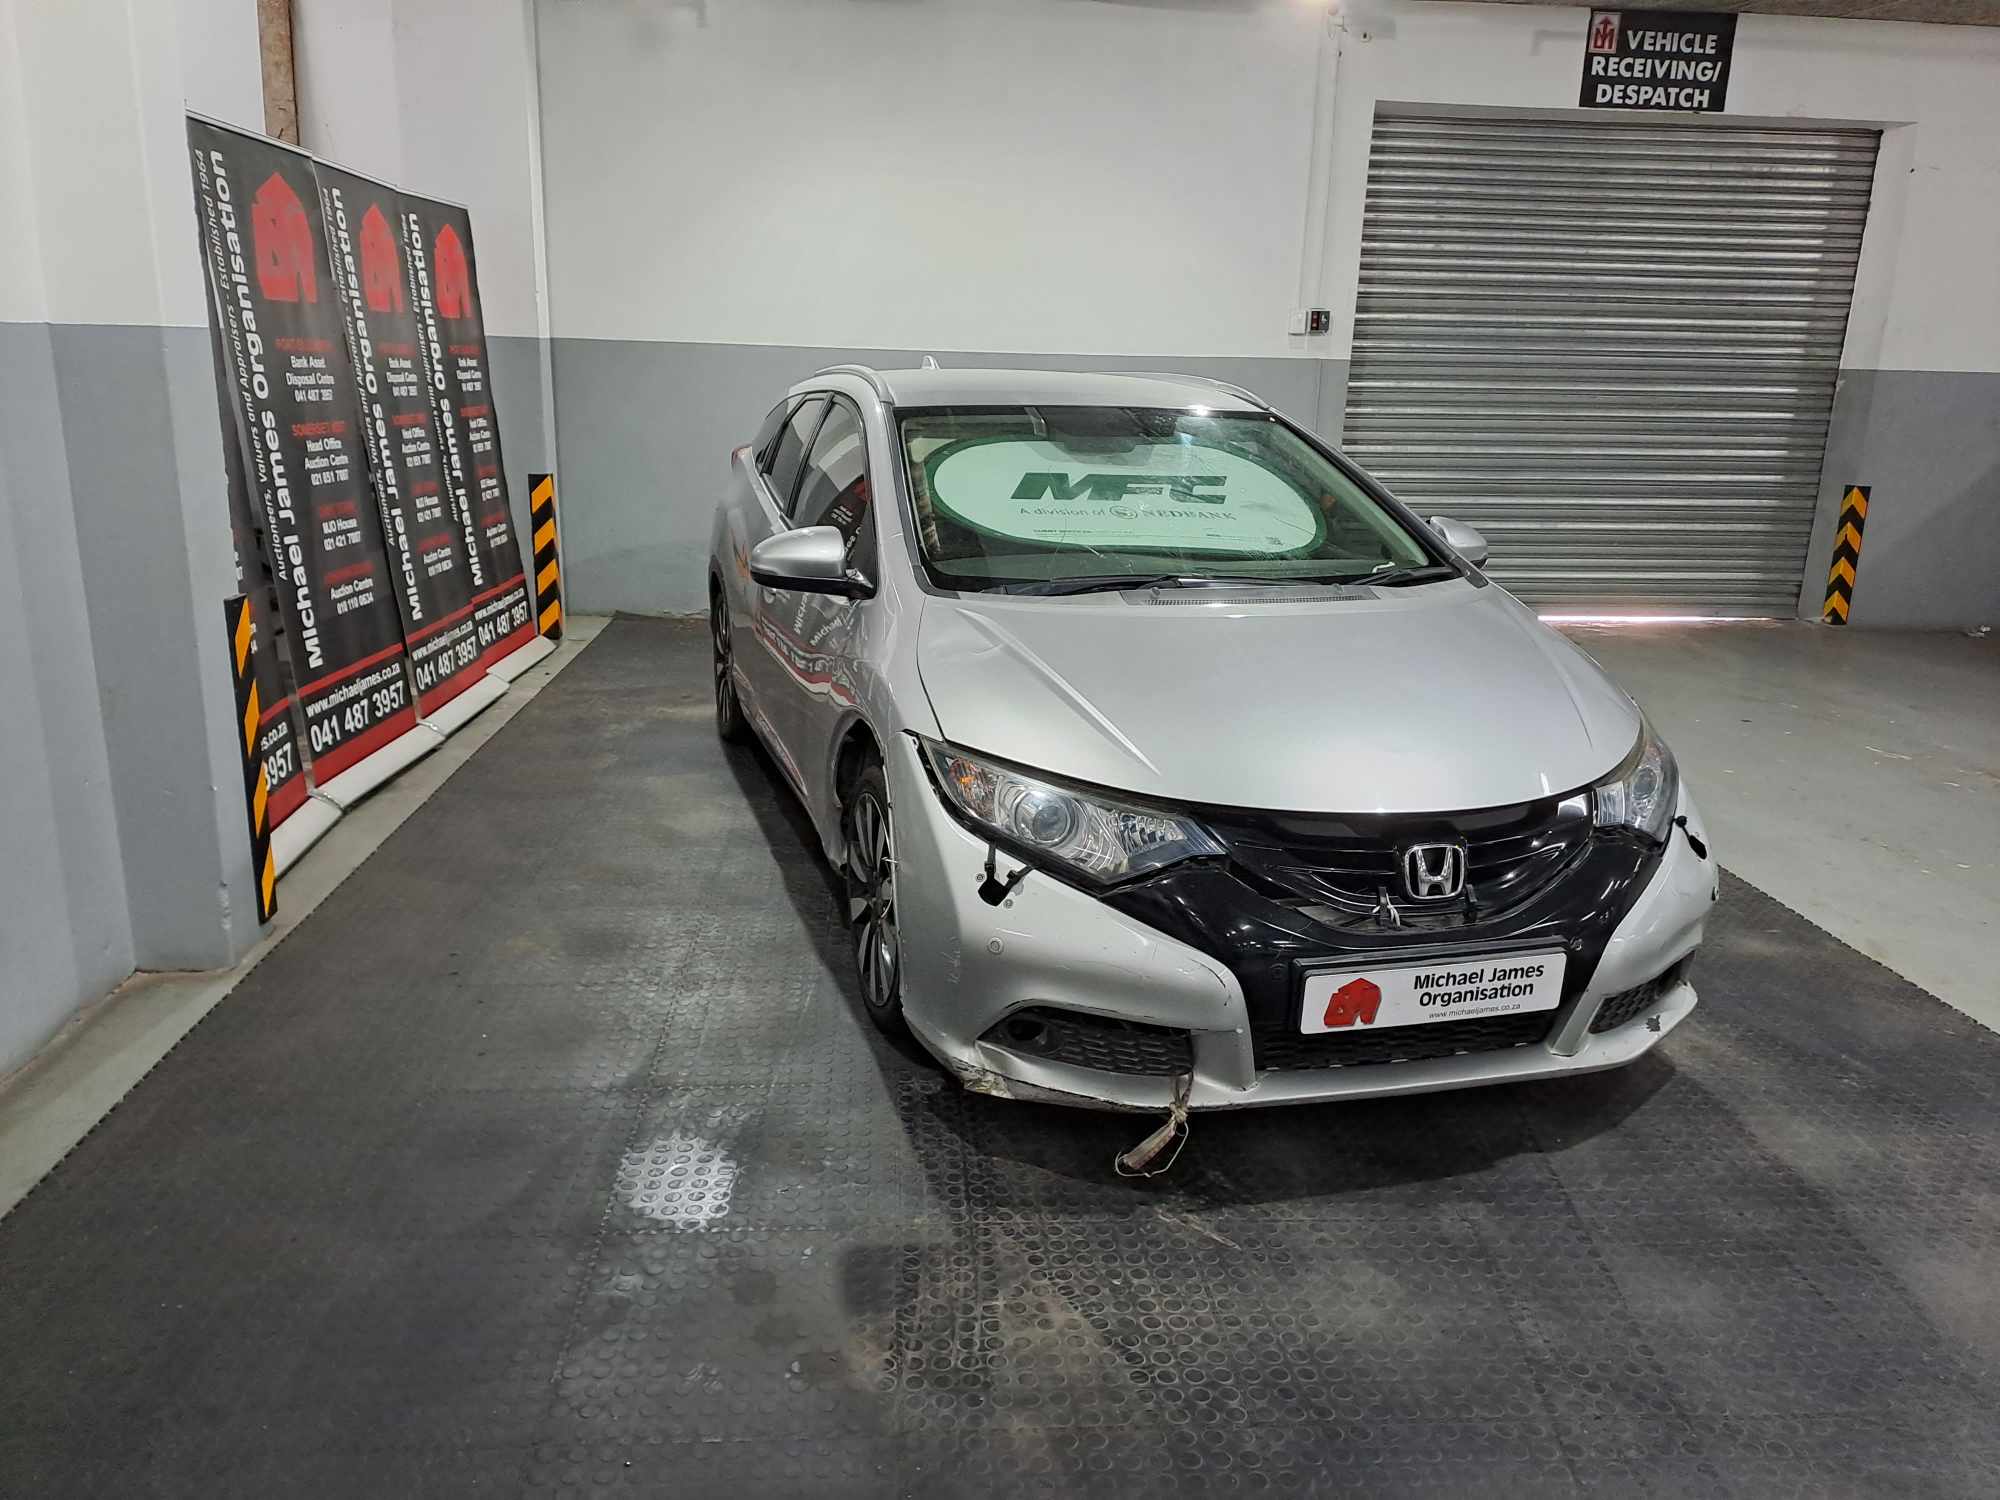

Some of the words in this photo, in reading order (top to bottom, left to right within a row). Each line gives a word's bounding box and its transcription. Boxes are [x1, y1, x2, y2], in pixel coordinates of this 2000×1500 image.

[1591, 56, 1723, 82] RECEIVING/
[1627, 30, 1718, 55] VEHICLE
[1596, 84, 1710, 108] DESPATCH
[194, 149, 211, 190] 1964
[203, 194, 231, 291] Established
[210, 150, 269, 400] Organisation
[331, 187, 378, 395] Organisation
[409, 213, 446, 391] Organisation
[226, 303, 250, 389] Appraisers
[241, 391, 256, 422] and
[440, 398, 463, 481] James
[250, 426, 268, 483] Valuers
[261, 410, 296, 526] James
[372, 403, 399, 500] James
[390, 507, 424, 621] Michael
[456, 488, 484, 586] Michael
[283, 534, 324, 670] Michael
[478, 621, 496, 647] 041
[496, 611, 511, 637] 487
[511, 600, 528, 627] 3957
[305, 662, 401, 718] www.michaeljames.co.za
[416, 661, 437, 690] 041
[438, 649, 455, 676] 487
[455, 635, 477, 666] 3957
[310, 714, 341, 753] 041
[344, 699, 369, 733] 487
[372, 680, 404, 718] 3957
[1413, 968, 1485, 990] Michael
[1488, 964, 1545, 982] James
[1420, 983, 1534, 1007] Organisation
